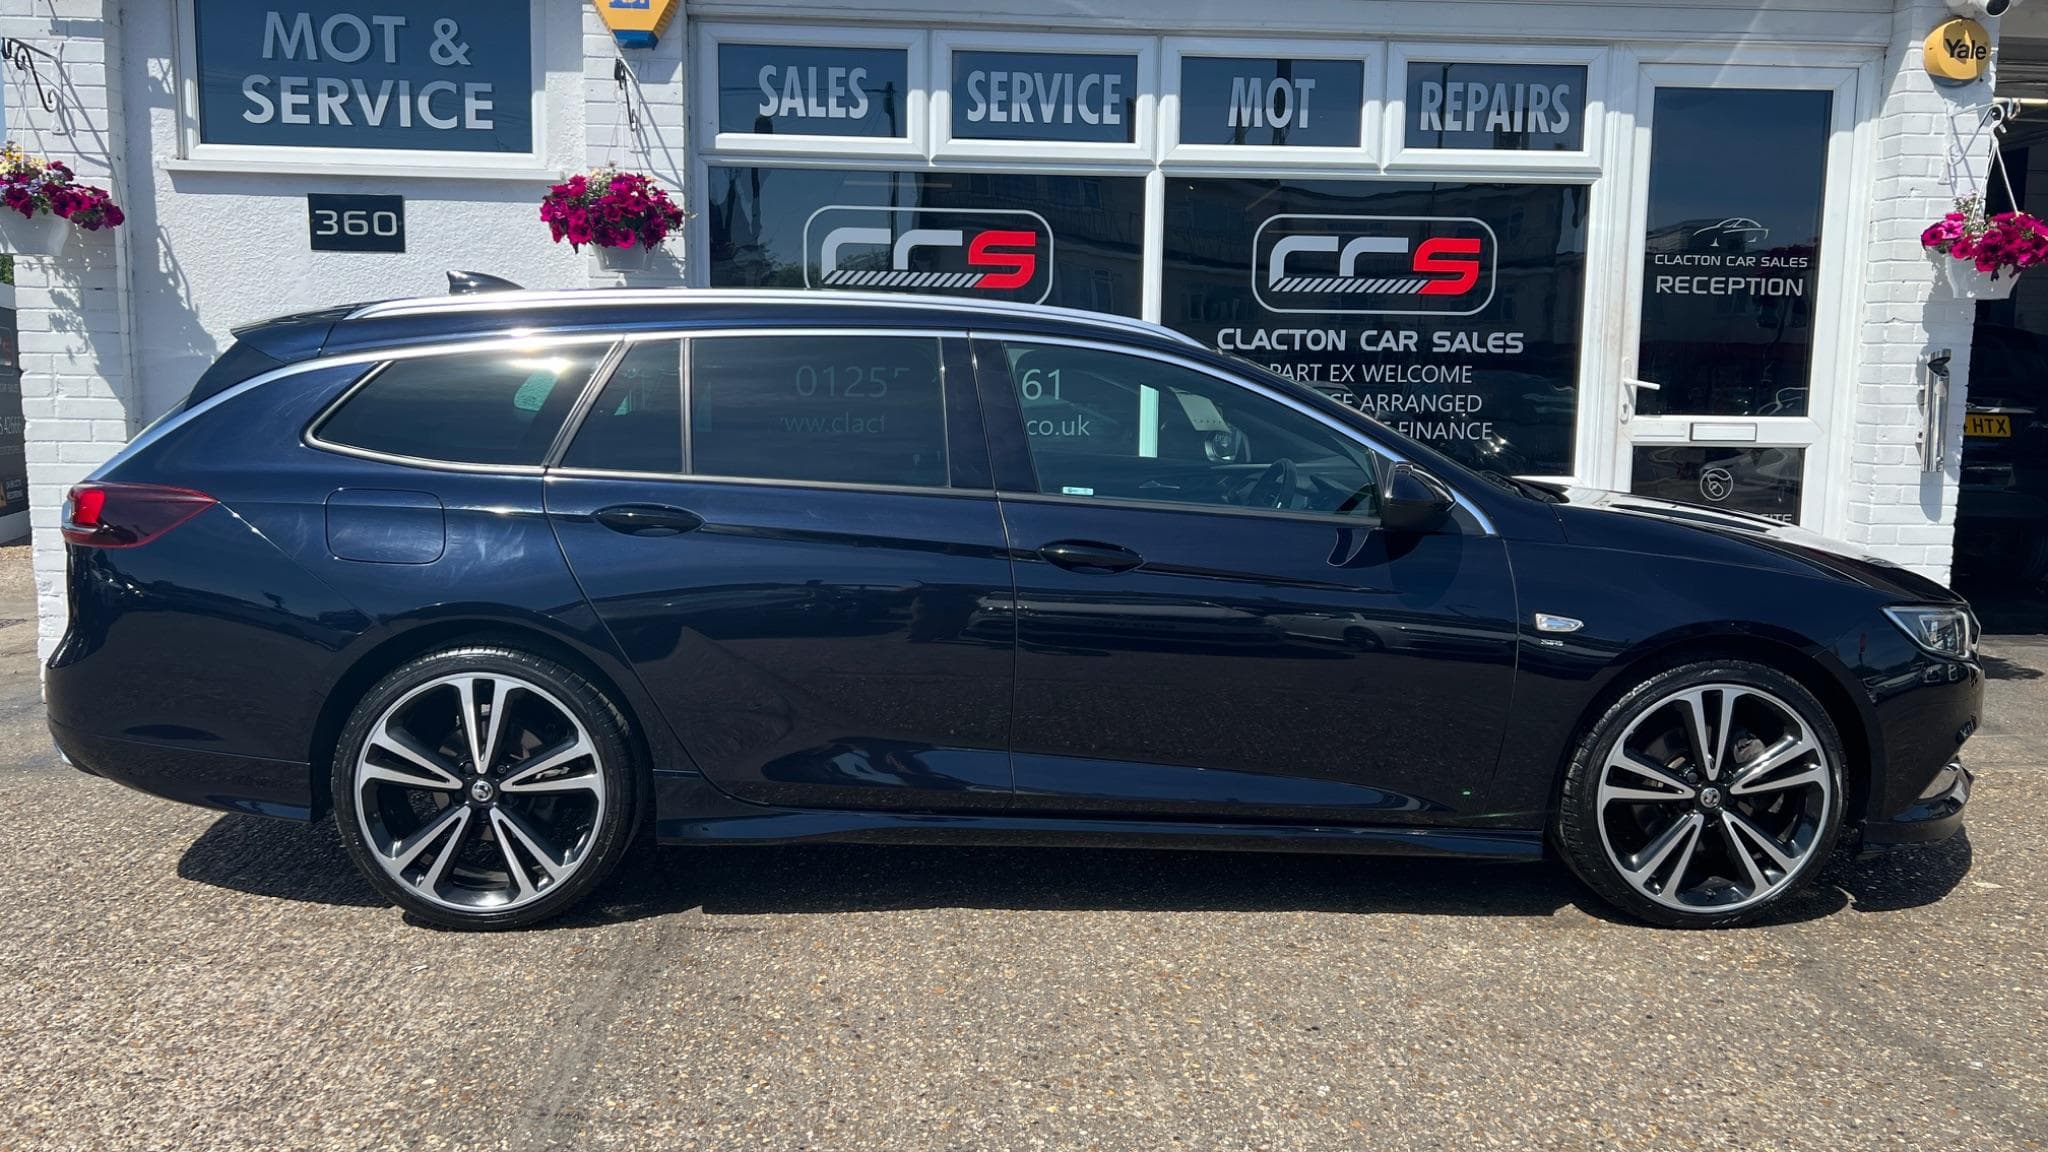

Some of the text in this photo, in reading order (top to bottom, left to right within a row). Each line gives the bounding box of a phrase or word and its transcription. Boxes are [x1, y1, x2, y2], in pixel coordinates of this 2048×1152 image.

[262, 11, 472, 66] MOT &
[1945, 39, 1987, 60] Yale
[242, 74, 496, 130] SERVICE
[758, 65, 869, 119] SALES
[967, 70, 1122, 125] SERVICE
[1228, 77, 1316, 129] MOT
[1420, 81, 1570, 134] REPAIRS
[315, 210, 397, 236] 360
[1655, 254, 1808, 268] CLACTON CAR SALES
[1656, 275, 1803, 297] RECEPTION
[1217, 328, 1524, 353] CLACTON CAR SALES
[1021, 368, 1060, 400] 61
[1329, 364, 1355, 382] EX
[1362, 365, 1473, 383] WELCOME
[1360, 394, 1482, 412] ARRANGED
[1399, 422, 1493, 440] FINANCE
[1973, 418, 2007, 434] HTX
